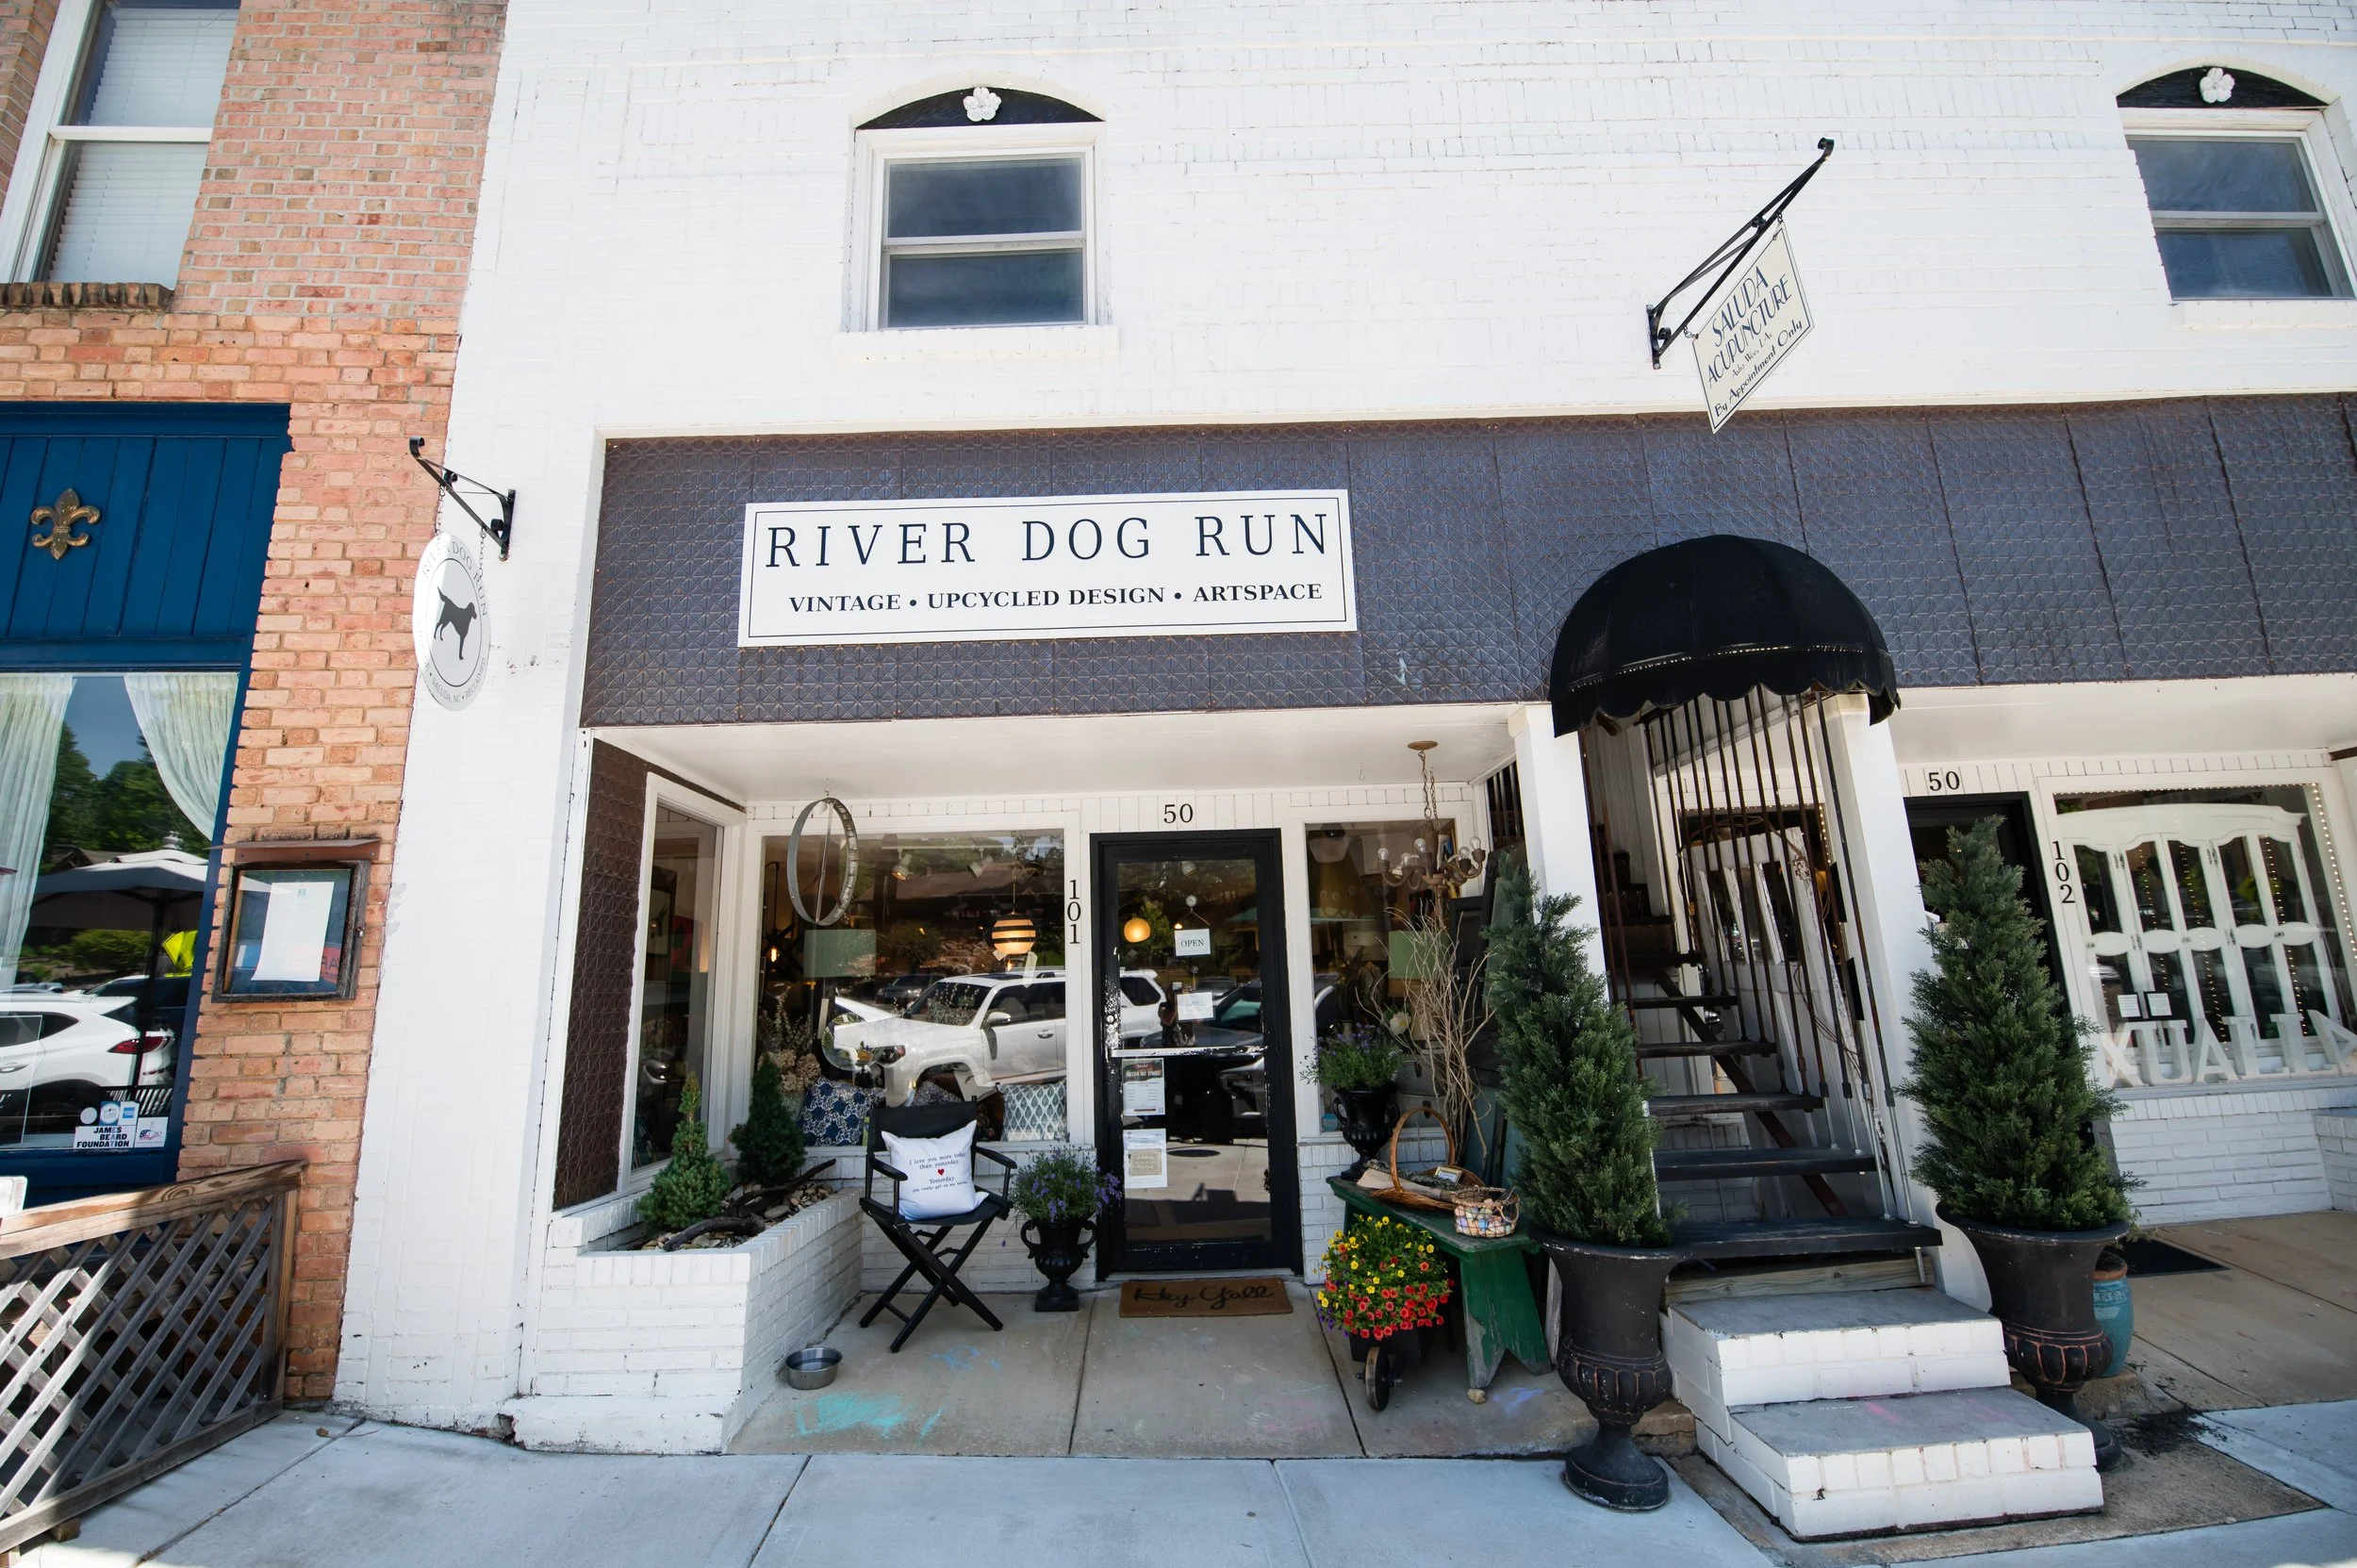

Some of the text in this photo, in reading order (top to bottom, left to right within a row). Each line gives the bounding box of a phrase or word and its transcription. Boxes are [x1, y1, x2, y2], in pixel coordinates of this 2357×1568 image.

[1711, 265, 1770, 348] SALUDA
[1707, 272, 1792, 389] ACUPUNCTURE
[1714, 320, 1803, 418] By Appointment Only
[766, 513, 1327, 568] RIVER DOG RUN
[452, 541, 473, 570] DOG
[473, 571, 487, 616] RUN
[789, 583, 1323, 613] VINTAGE UPCYCLED DESIGN ARTSPACE
[1928, 770, 1960, 791] 50
[1163, 803, 1194, 824] 50
[2052, 840, 2076, 904] 102
[1066, 879, 1081, 945] 101
[1180, 938, 1205, 948] OPEN
[76, 1140, 130, 1148] FOUNDATION
[934, 1160, 959, 1168] yesterday
[929, 1176, 955, 1184] Yesterday
